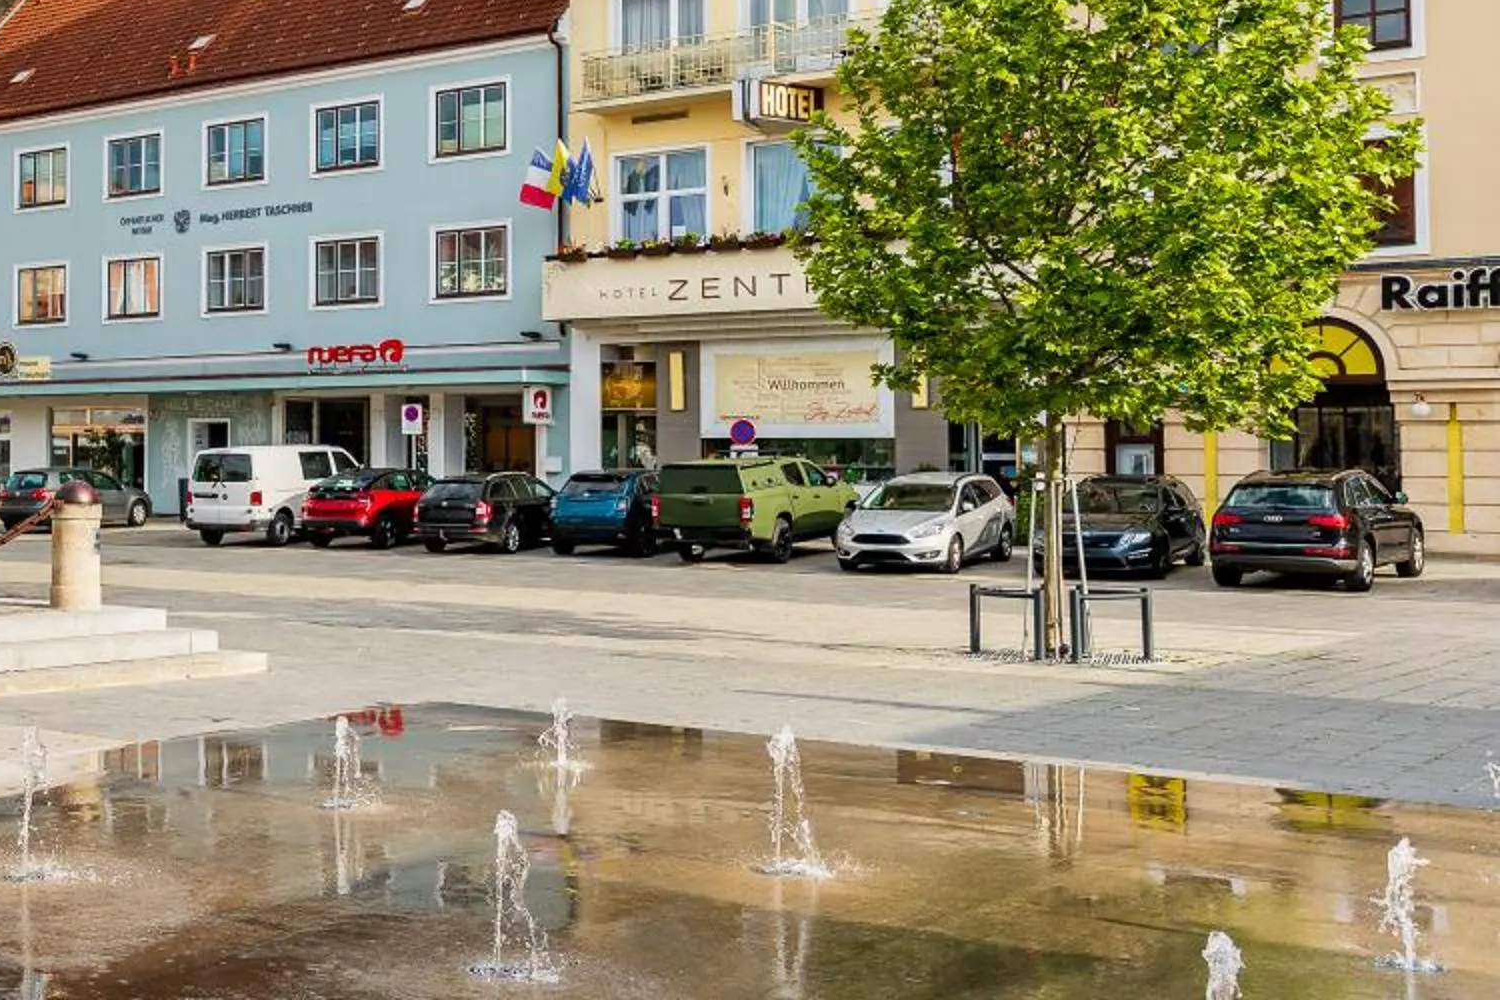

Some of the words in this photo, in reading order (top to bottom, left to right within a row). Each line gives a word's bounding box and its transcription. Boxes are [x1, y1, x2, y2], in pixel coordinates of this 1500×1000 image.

[221, 206, 262, 221] HERBERT
[264, 201, 313, 217] TASCHNER
[599, 287, 658, 299] HOTEL
